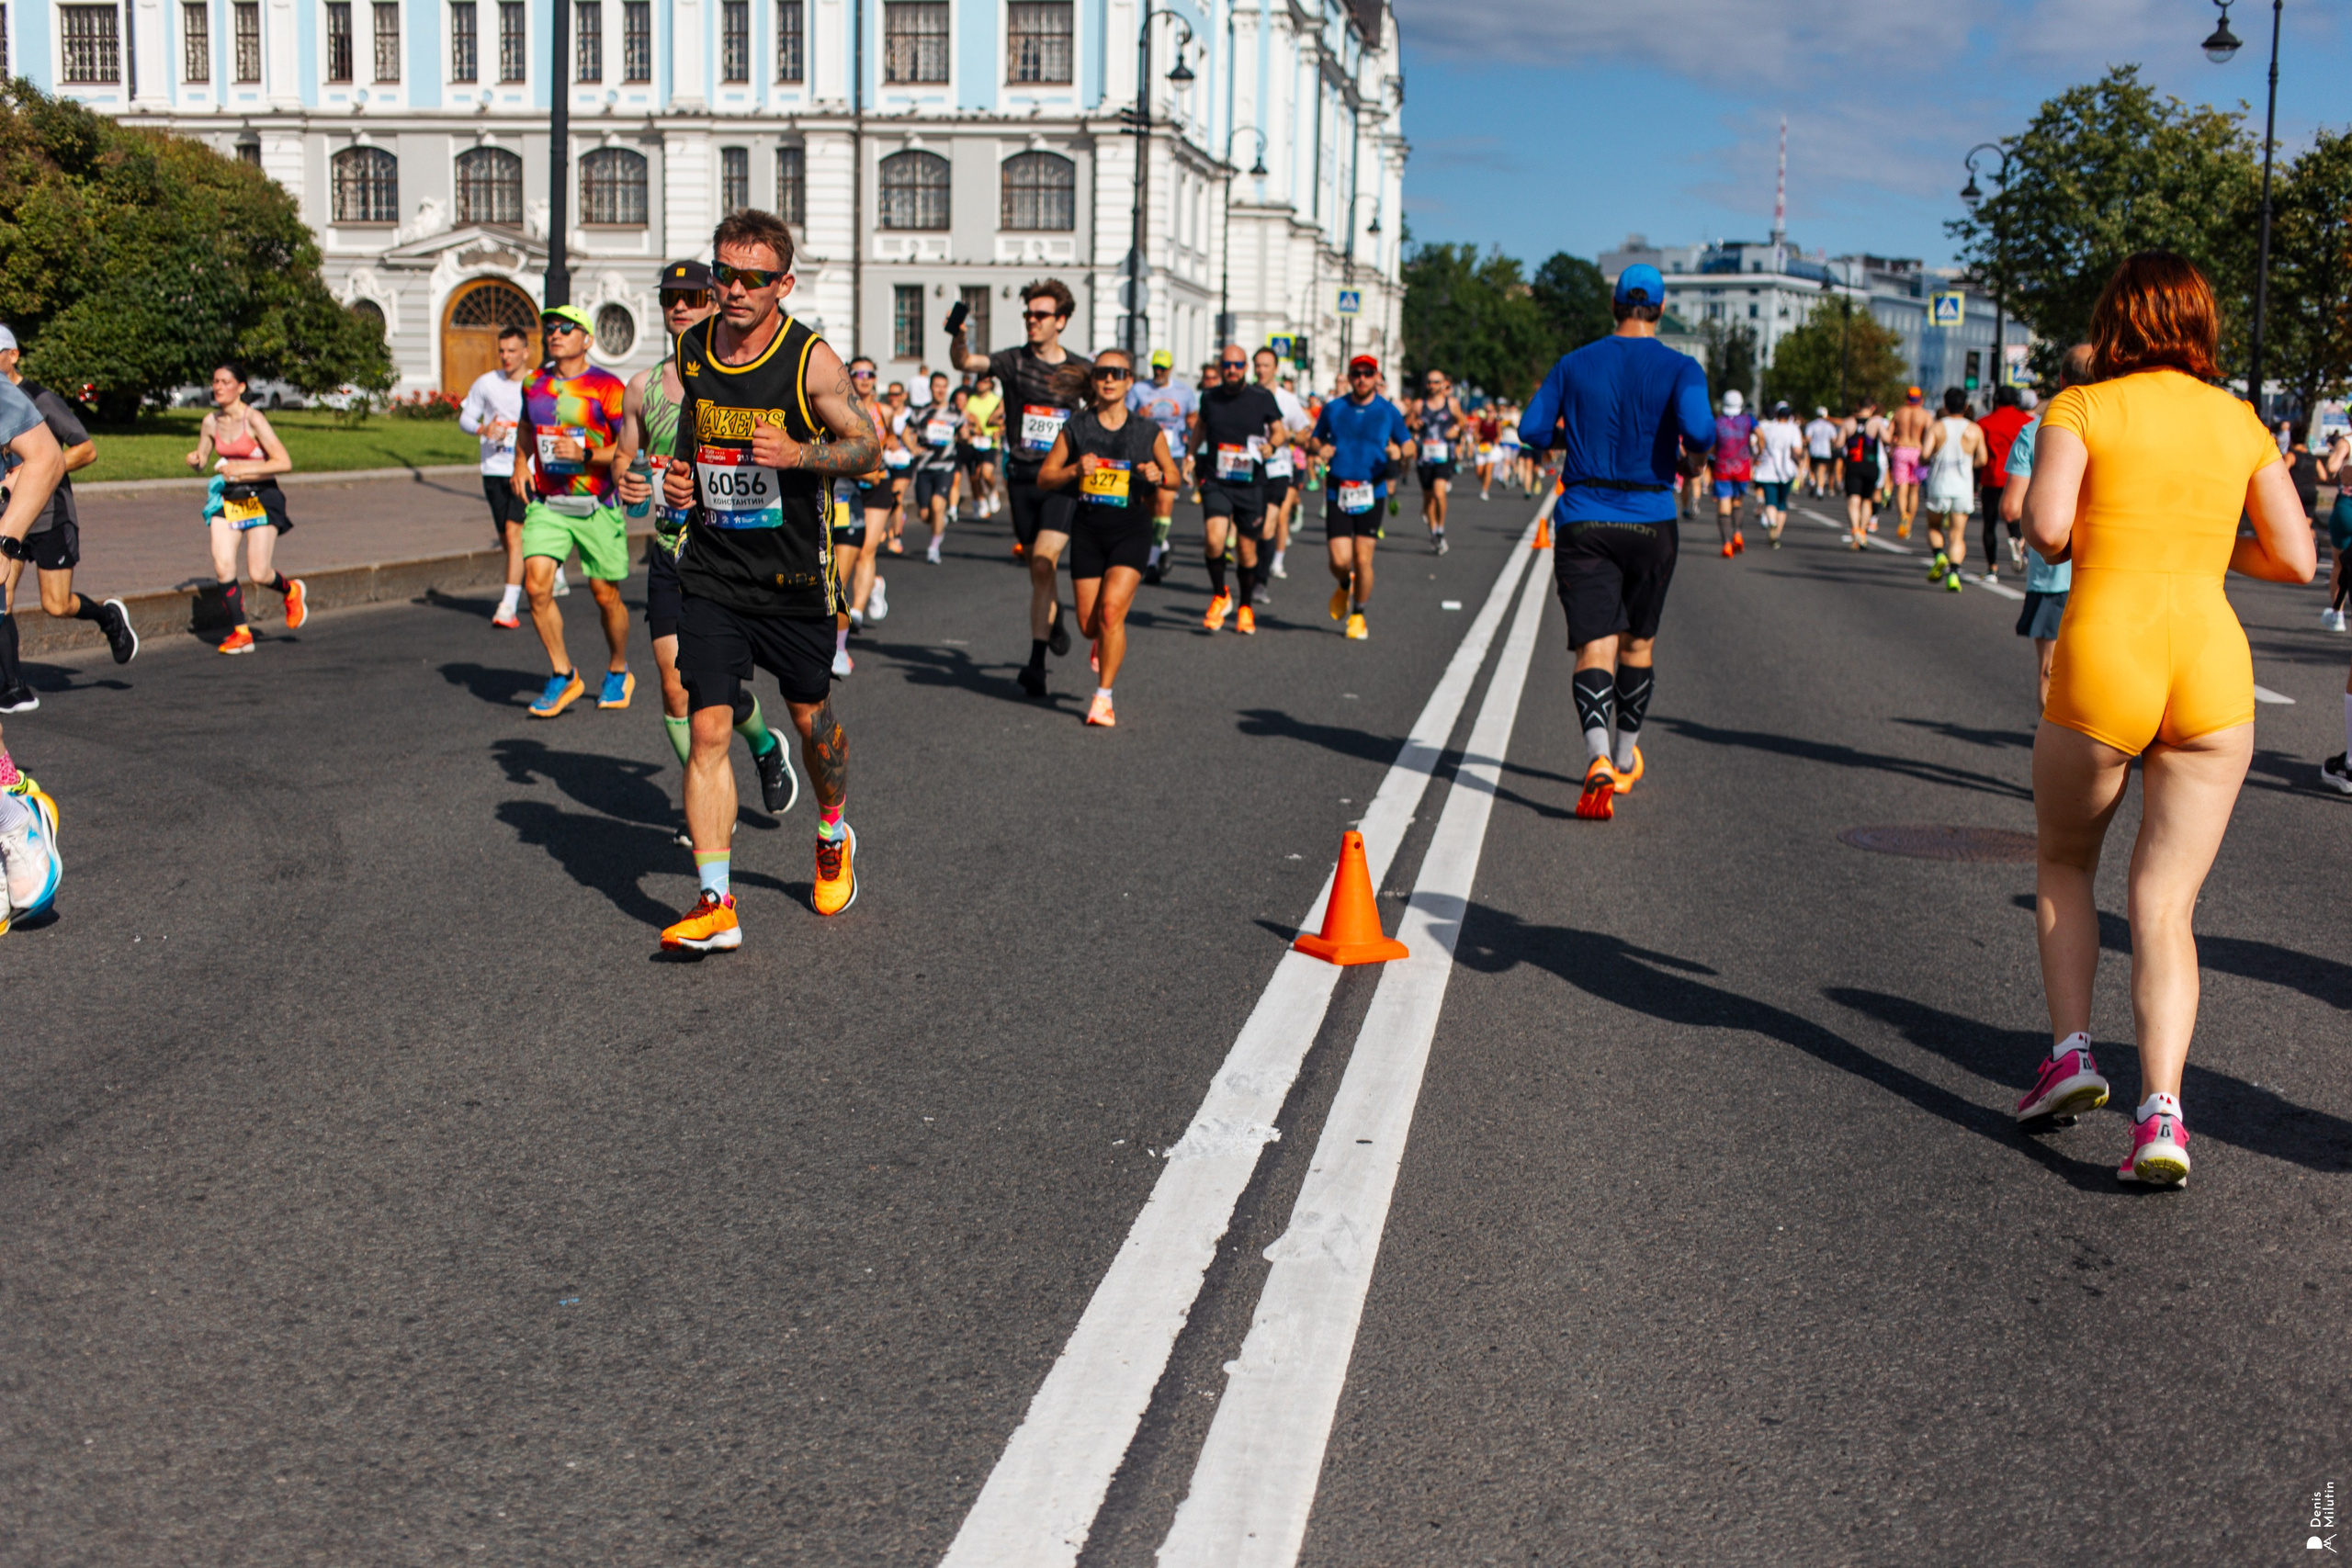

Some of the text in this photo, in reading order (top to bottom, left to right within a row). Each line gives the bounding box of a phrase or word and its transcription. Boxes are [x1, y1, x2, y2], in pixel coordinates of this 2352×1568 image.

[695, 398, 787, 443] LAKERS
[708, 471, 767, 496] 6056
[713, 497, 764, 505] КОНСТАНТИН
